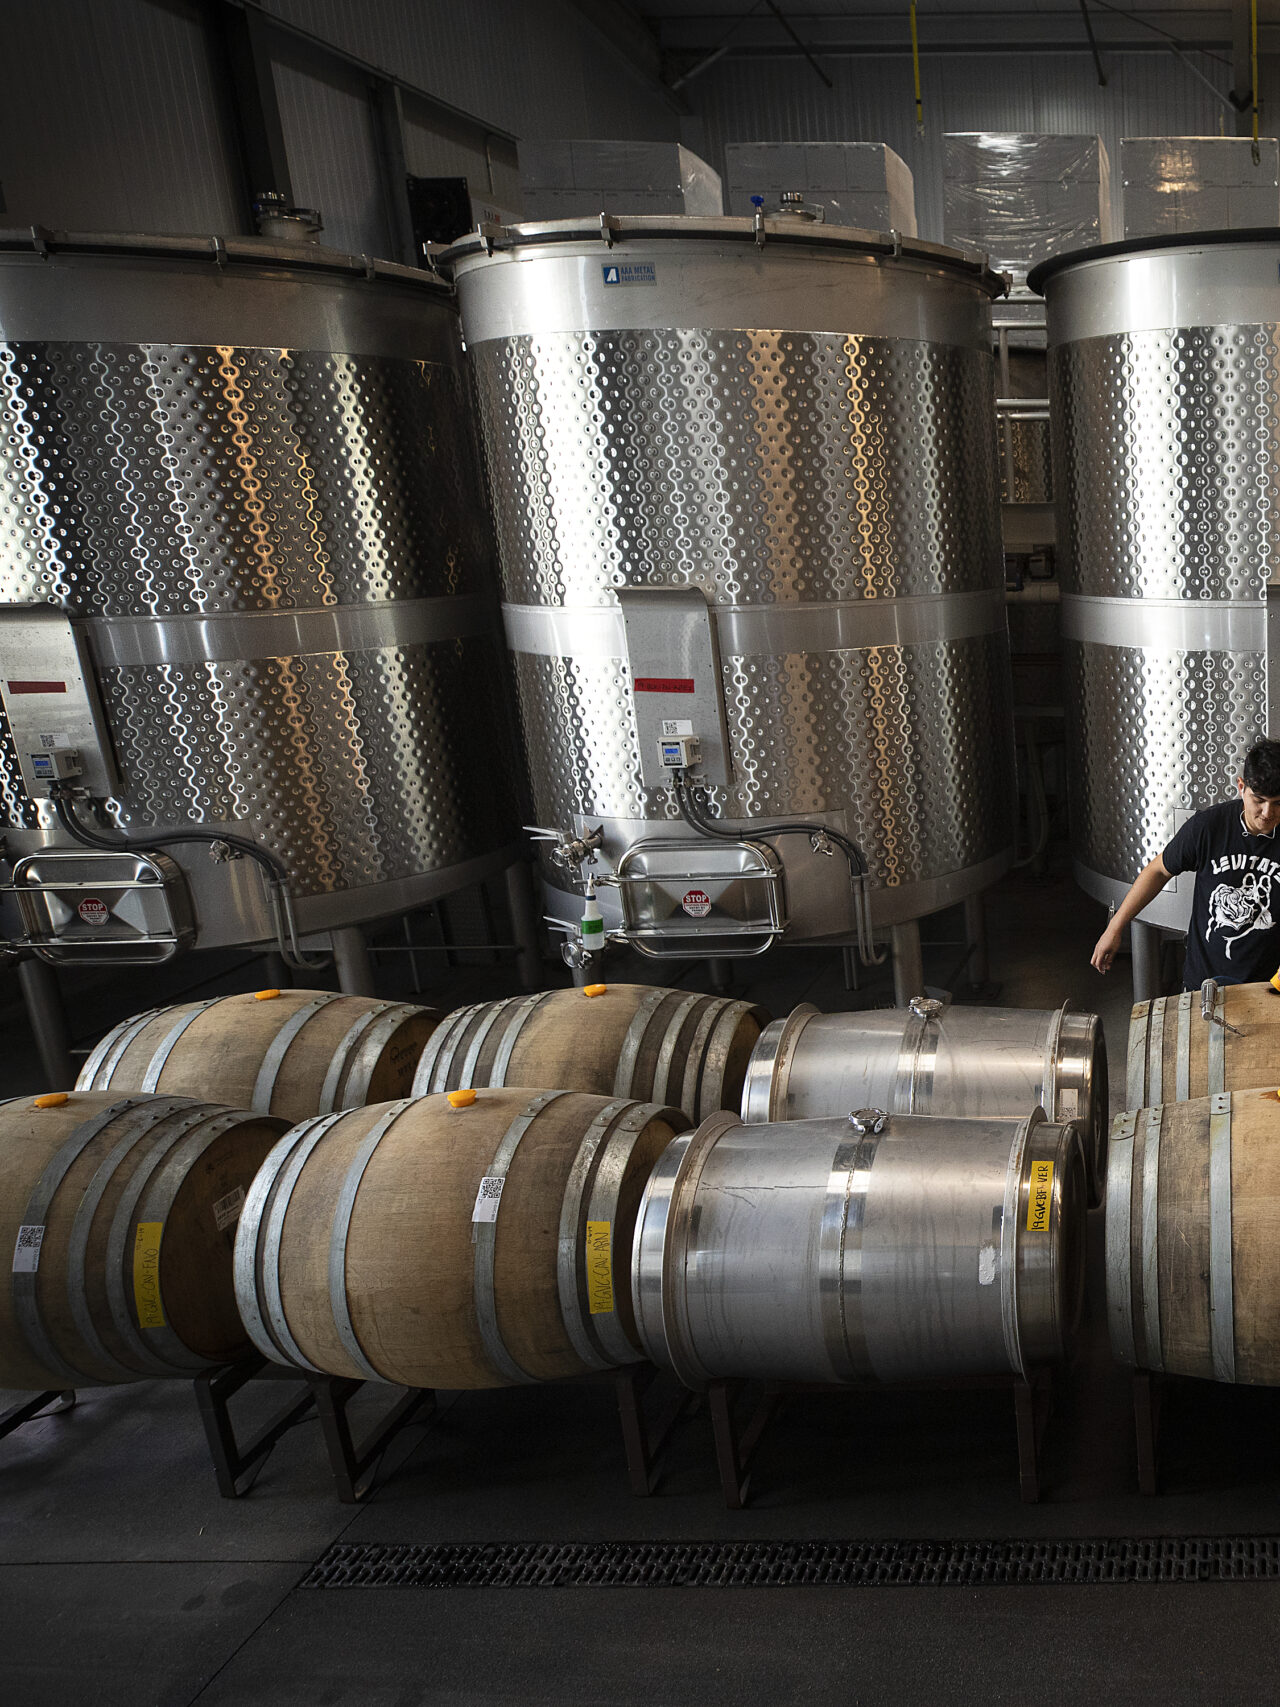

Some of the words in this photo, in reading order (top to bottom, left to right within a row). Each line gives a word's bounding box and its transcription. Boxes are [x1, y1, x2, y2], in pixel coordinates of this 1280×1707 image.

[621, 266, 632, 274] AAA
[634, 265, 654, 273] METAL
[686, 894, 707, 903] STOP
[82, 903, 103, 911] STOP
